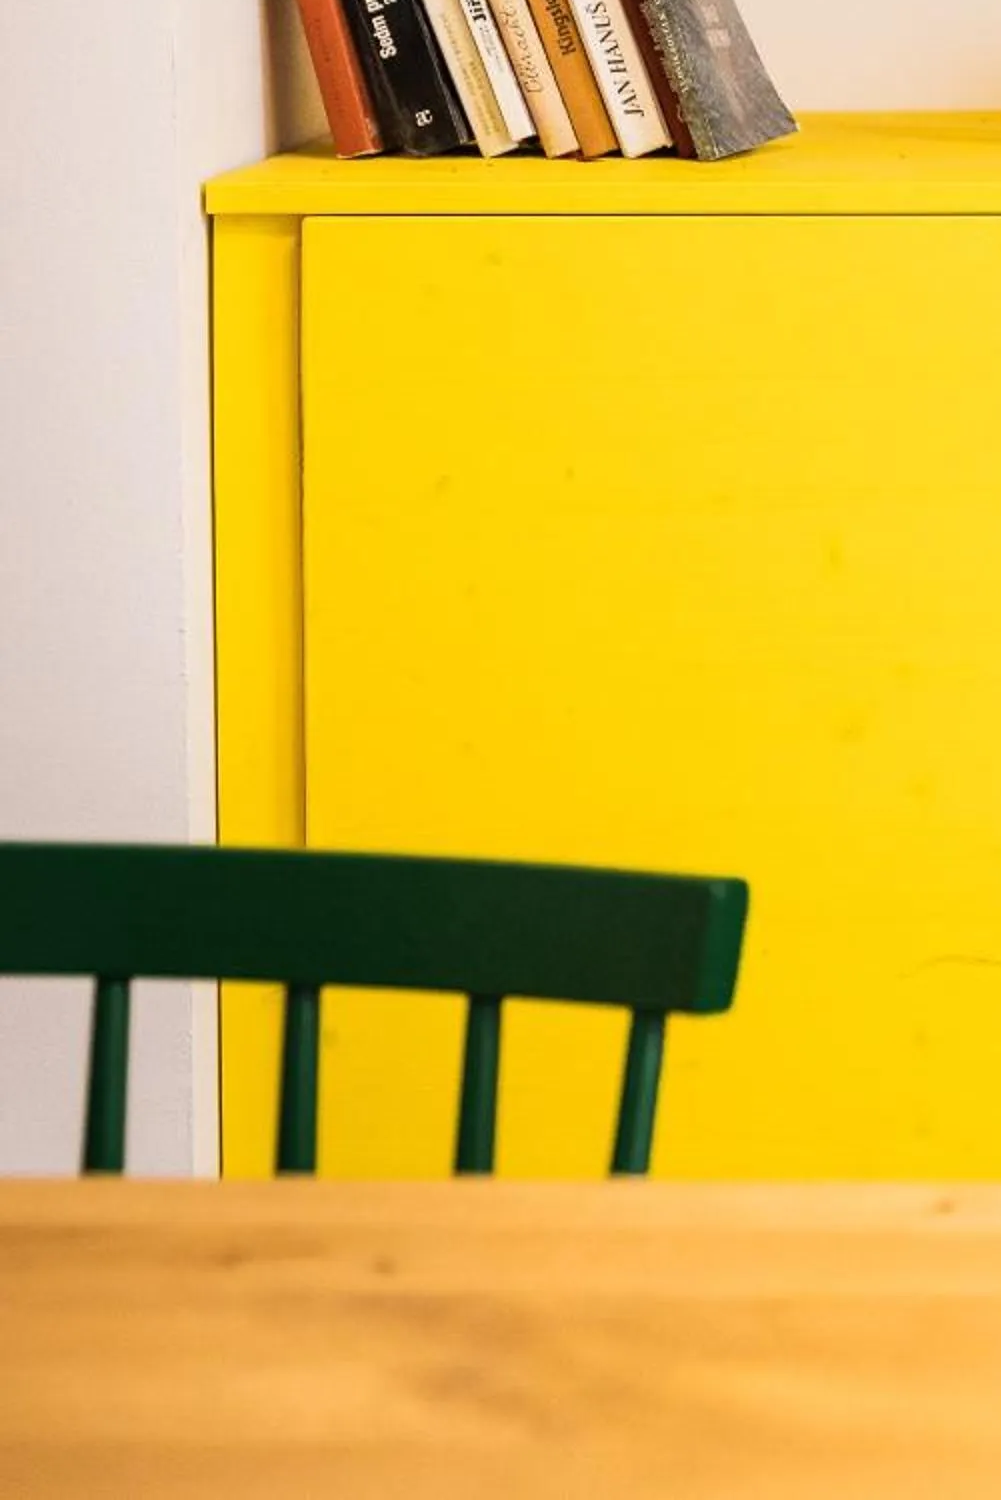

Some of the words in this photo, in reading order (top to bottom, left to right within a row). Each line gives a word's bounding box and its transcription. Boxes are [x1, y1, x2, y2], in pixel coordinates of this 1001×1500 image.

[368, 14, 397, 58] Sedm
[584, 1, 628, 75] HANUŠ
[615, 78, 645, 118] JAN
